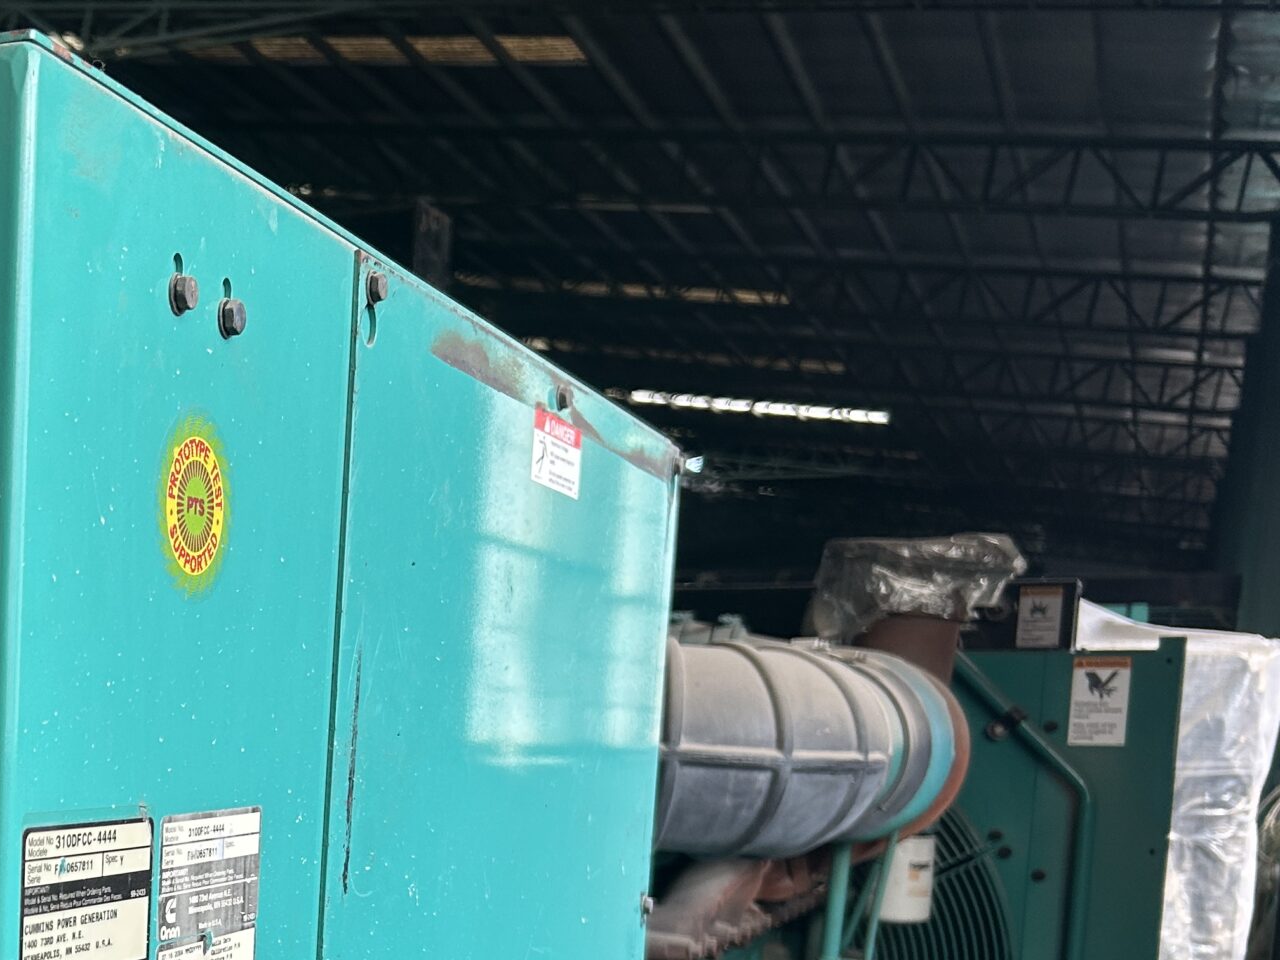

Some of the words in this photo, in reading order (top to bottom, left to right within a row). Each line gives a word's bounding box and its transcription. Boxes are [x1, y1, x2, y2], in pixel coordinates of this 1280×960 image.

[169, 439, 210, 499] PROTOTYPE
[211, 460, 222, 511] TEST
[187, 497, 204, 517] PTS
[170, 524, 217, 573] SUPPORTED
[28, 836, 45, 847] Model
[55, 829, 116, 849] 310DFCC-4444
[28, 863, 42, 874] Serial
[54, 860, 93, 875] F0657811
[25, 921, 53, 935] CUMMINS
[57, 916, 76, 929] POWER
[81, 909, 117, 925] GENERATION
[25, 940, 37, 949] 1400
[40, 937, 53, 946] 73RD
[56, 934, 68, 943] AVE.
[161, 926, 180, 940] Onan
